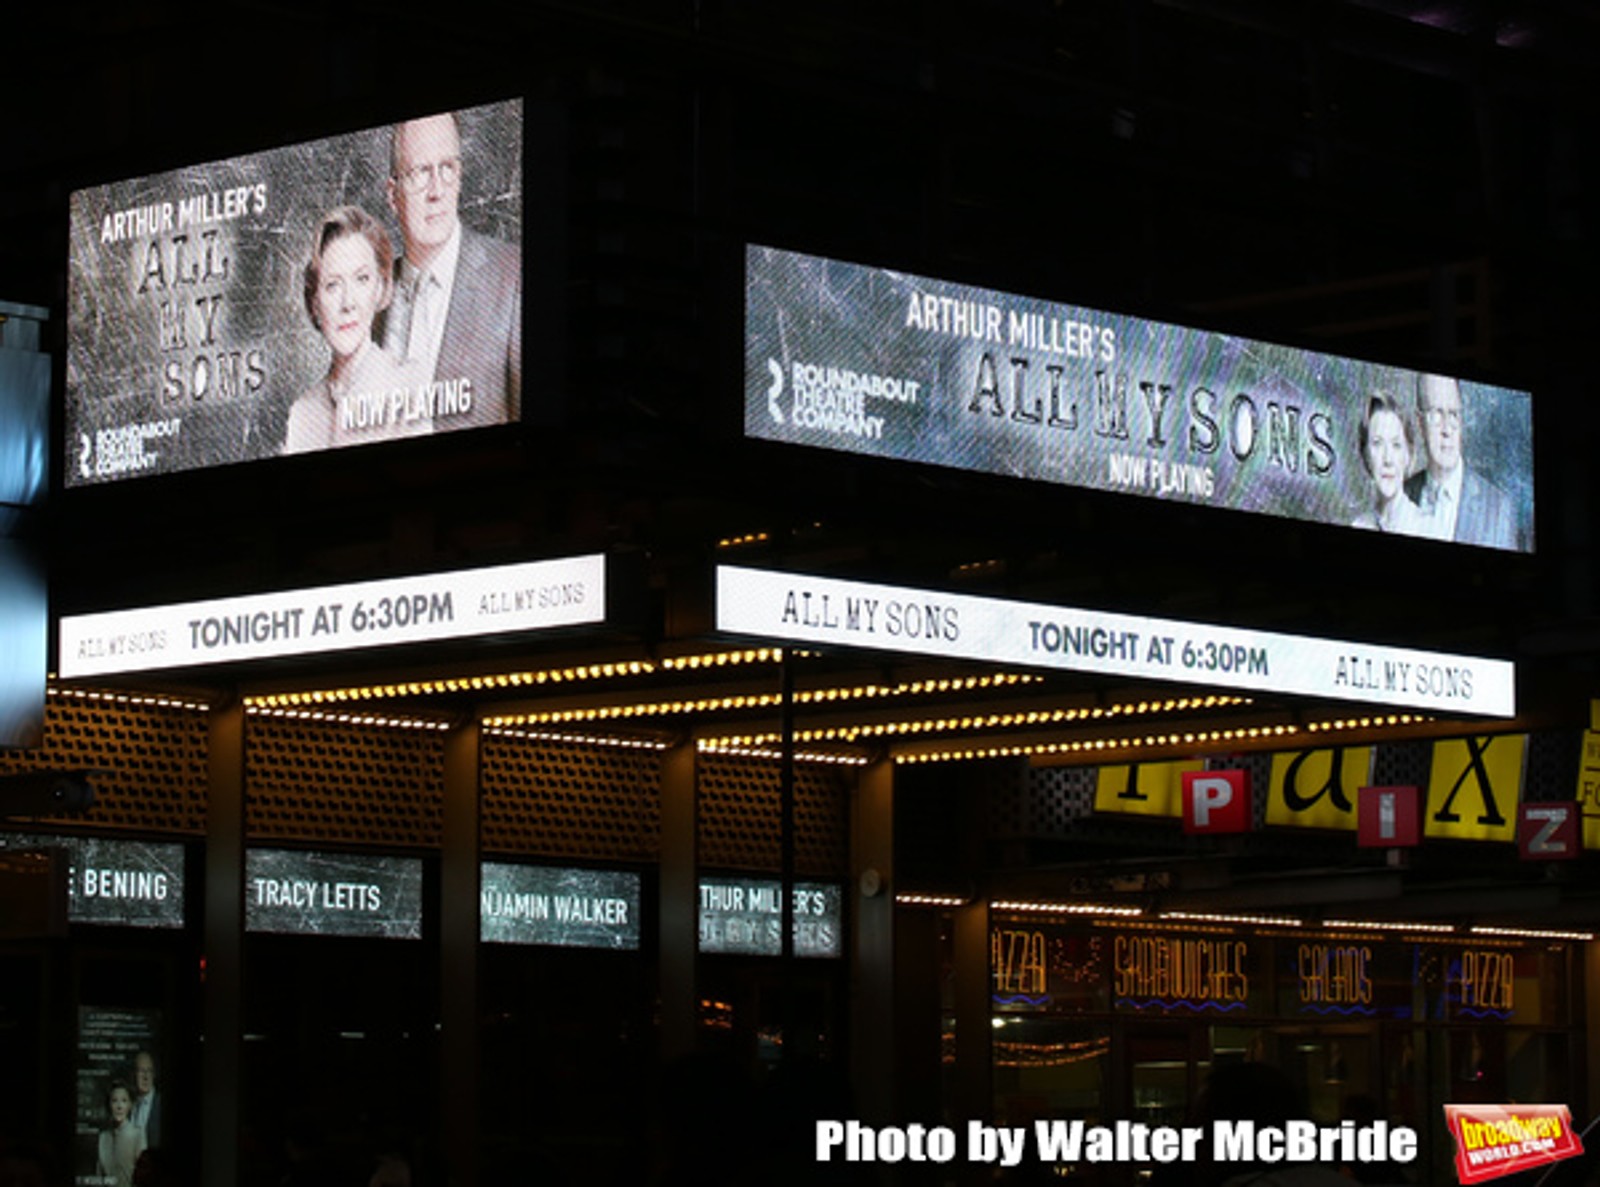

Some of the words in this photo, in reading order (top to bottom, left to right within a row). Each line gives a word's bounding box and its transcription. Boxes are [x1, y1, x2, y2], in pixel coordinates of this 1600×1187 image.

[101, 201, 174, 244] ARTHUR
[178, 183, 268, 228] MILLER'S
[137, 229, 231, 294] ALL
[905, 291, 1001, 342] ARTHUR
[1009, 311, 1116, 362] MILLER'S
[162, 350, 265, 404] SONS
[792, 361, 920, 404] ROUNDABOUT
[793, 388, 866, 414] THEATRE
[340, 389, 391, 430] NOW
[391, 377, 472, 421] PLAYING
[791, 409, 885, 440] COMPANY
[968, 351, 1078, 431] ALL
[1094, 369, 1172, 448] MY
[1189, 386, 1336, 478] SONS
[1108, 453, 1147, 489] NOW
[1150, 459, 1214, 497] PLAYING
[188, 607, 303, 649] TONIGHT
[311, 603, 341, 636] AT
[350, 592, 455, 633] 6:30PM
[477, 592, 511, 616] ALL
[510, 588, 539, 612] MY
[538, 581, 586, 609] SONS
[781, 590, 839, 629] ALL
[846, 597, 879, 633] MY
[884, 601, 960, 642] SONS
[77, 637, 105, 659] ALL
[128, 629, 168, 654] SONS
[1028, 620, 1139, 665] TONIGHT
[1146, 635, 1175, 665] AT
[1181, 640, 1270, 676] 6:30PM
[1334, 656, 1382, 690] ALL
[1384, 661, 1413, 693] MY
[1415, 664, 1474, 701] SONS
[83, 868, 168, 900] BENING
[253, 879, 317, 908] TRACY
[322, 883, 382, 911] LETTS
[554, 895, 628, 925] WALKER
[1114, 935, 1248, 1001] SANDWICHES
[1300, 944, 1373, 1003] SALADS
[1461, 951, 1514, 1009] PIZZA
